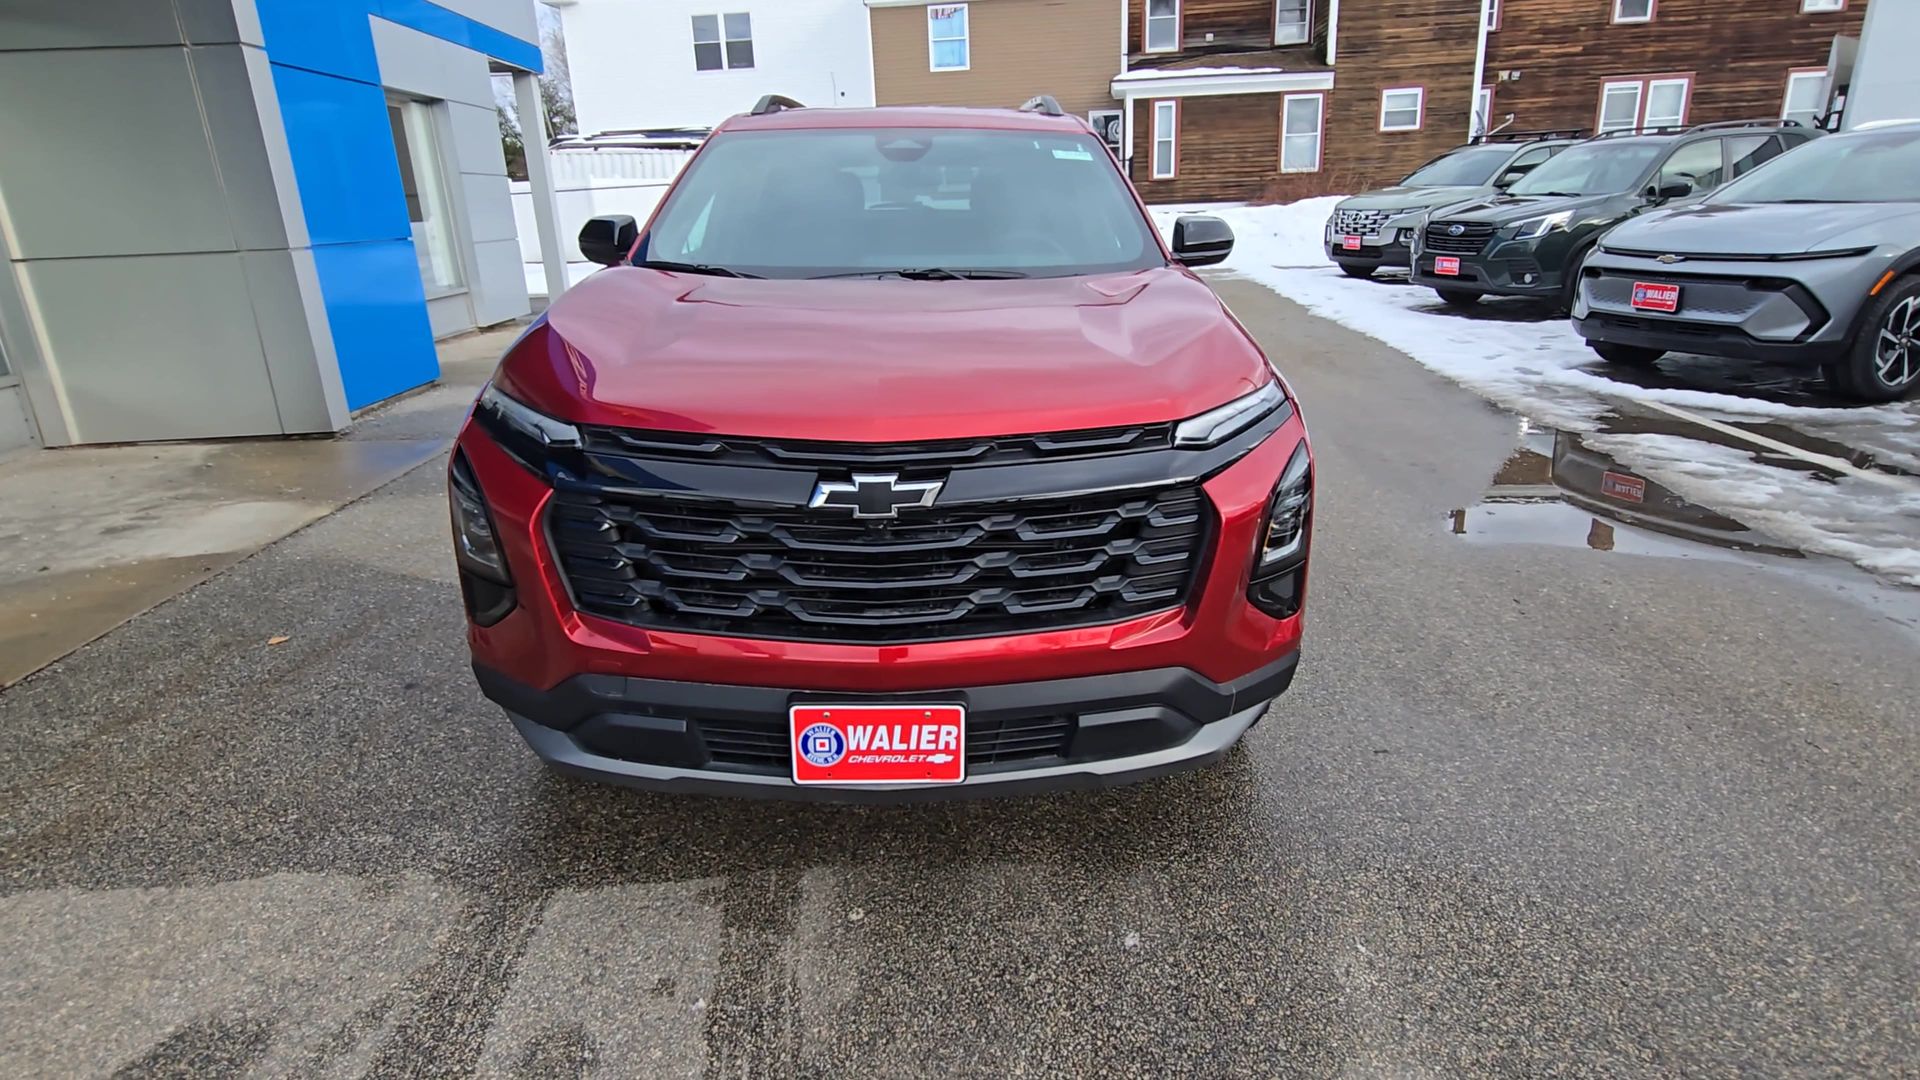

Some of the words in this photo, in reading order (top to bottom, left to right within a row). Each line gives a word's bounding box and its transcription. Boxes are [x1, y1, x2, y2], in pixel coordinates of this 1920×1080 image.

[1646, 289, 1677, 300] WALIER
[847, 725, 958, 750] WALIER
[848, 754, 926, 764] CHEVROLET
